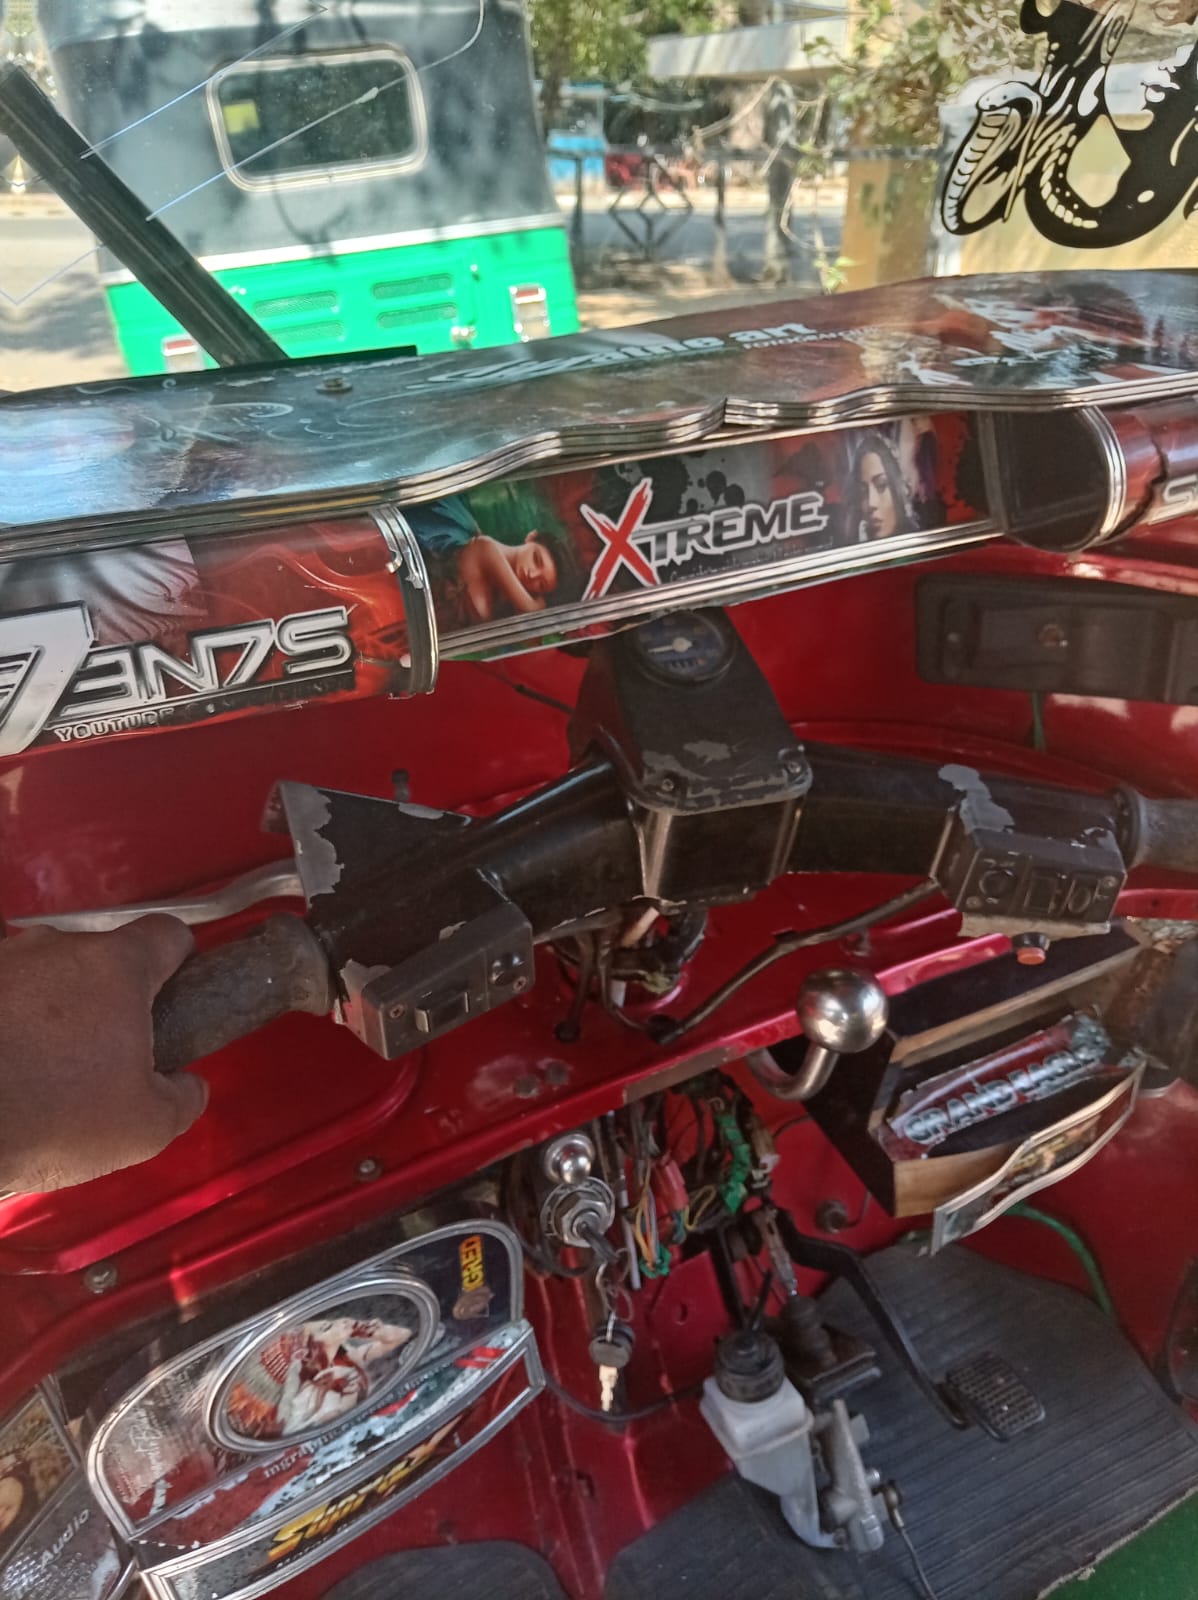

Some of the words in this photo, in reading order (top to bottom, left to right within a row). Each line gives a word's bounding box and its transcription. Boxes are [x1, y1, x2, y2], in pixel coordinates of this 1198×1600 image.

[580, 477, 829, 601] XTREME
[904, 1079, 1019, 1146] GRAND
[41, 1509, 89, 1570] Audio
